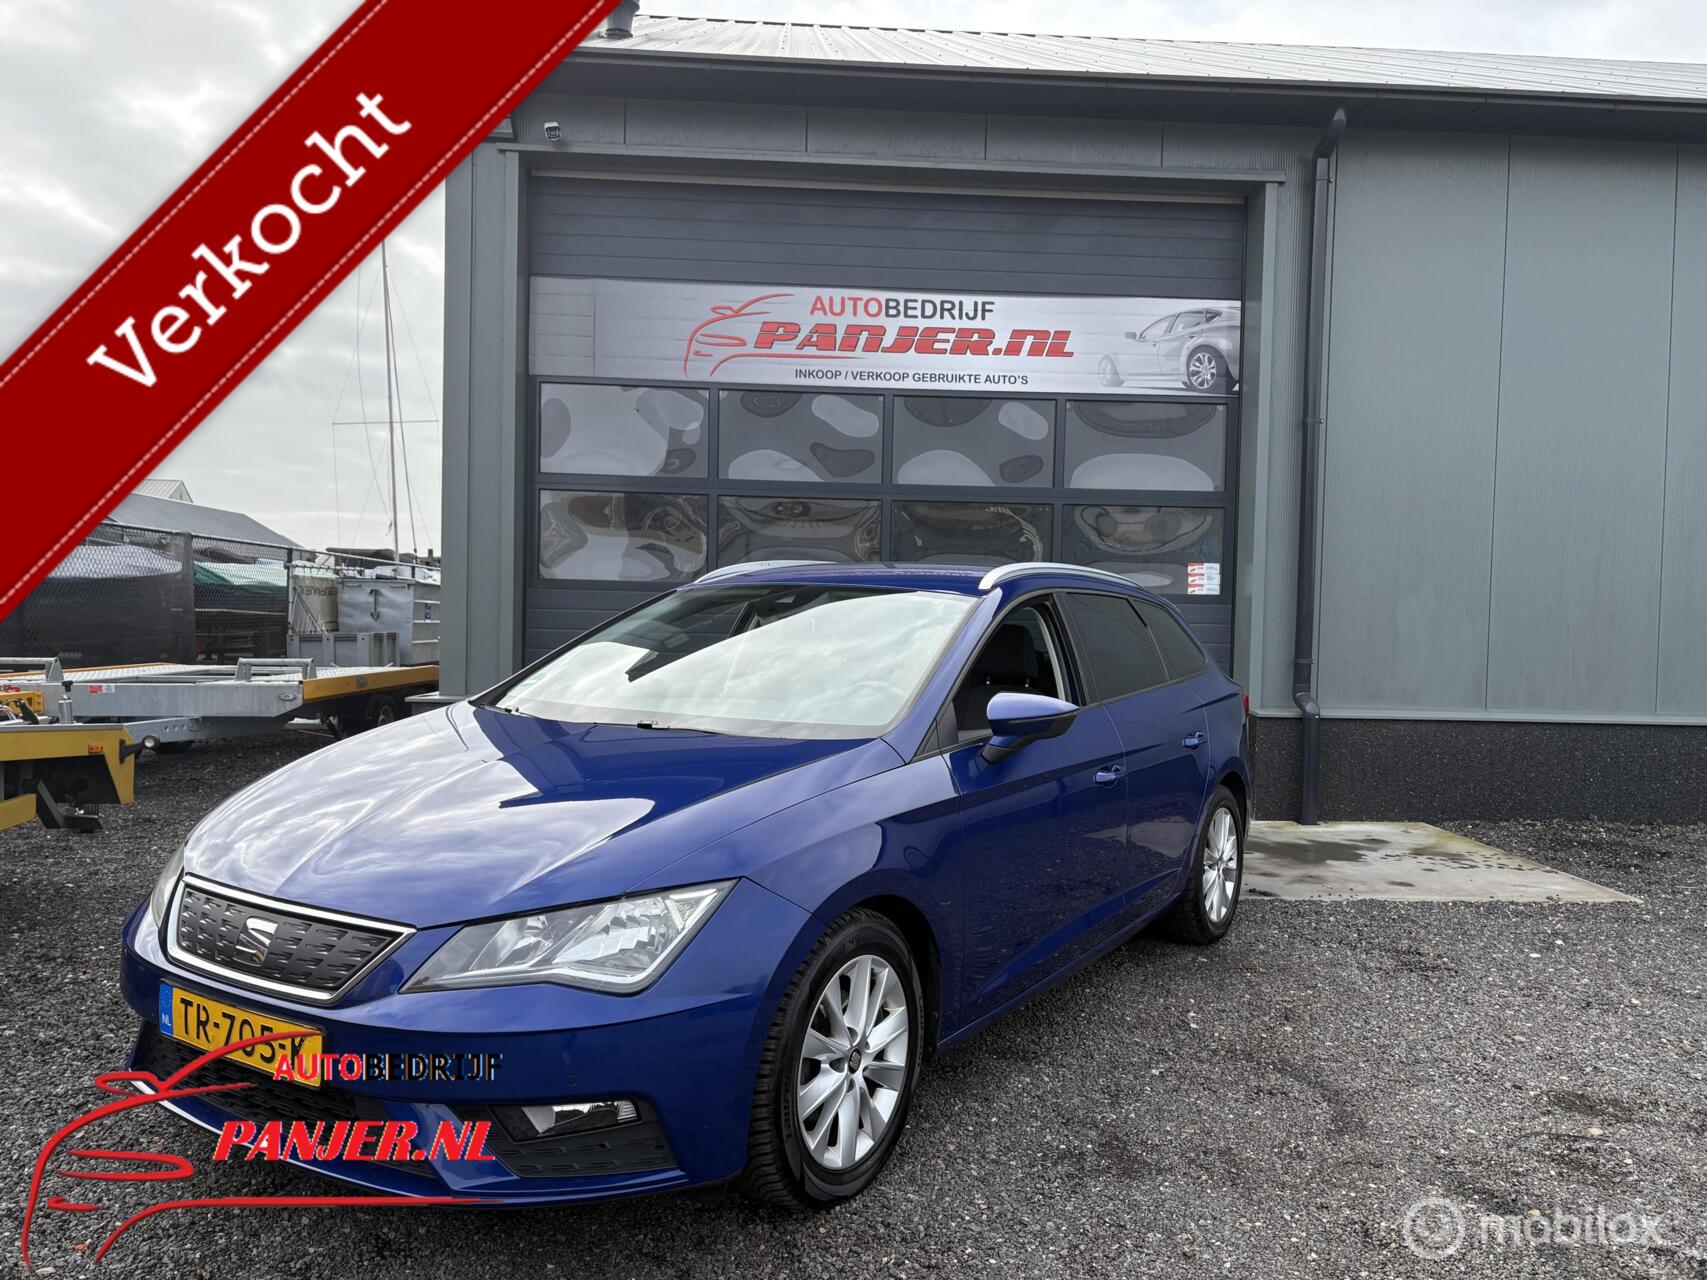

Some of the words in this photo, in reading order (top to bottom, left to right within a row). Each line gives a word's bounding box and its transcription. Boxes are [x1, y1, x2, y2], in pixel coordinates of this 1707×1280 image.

[809, 296, 996, 321] AUTOBEDRIJF
[753, 321, 1075, 358] PANJER.NL
[795, 368, 842, 381] INKOOP
[844, 371, 849, 381] /
[851, 371, 910, 383] VERKOOP
[912, 372, 982, 385] GEBRUIKTE
[984, 374, 1029, 386] AUTO'S
[161, 1013, 172, 1027] NL
[180, 997, 306, 1078] TR-705-K
